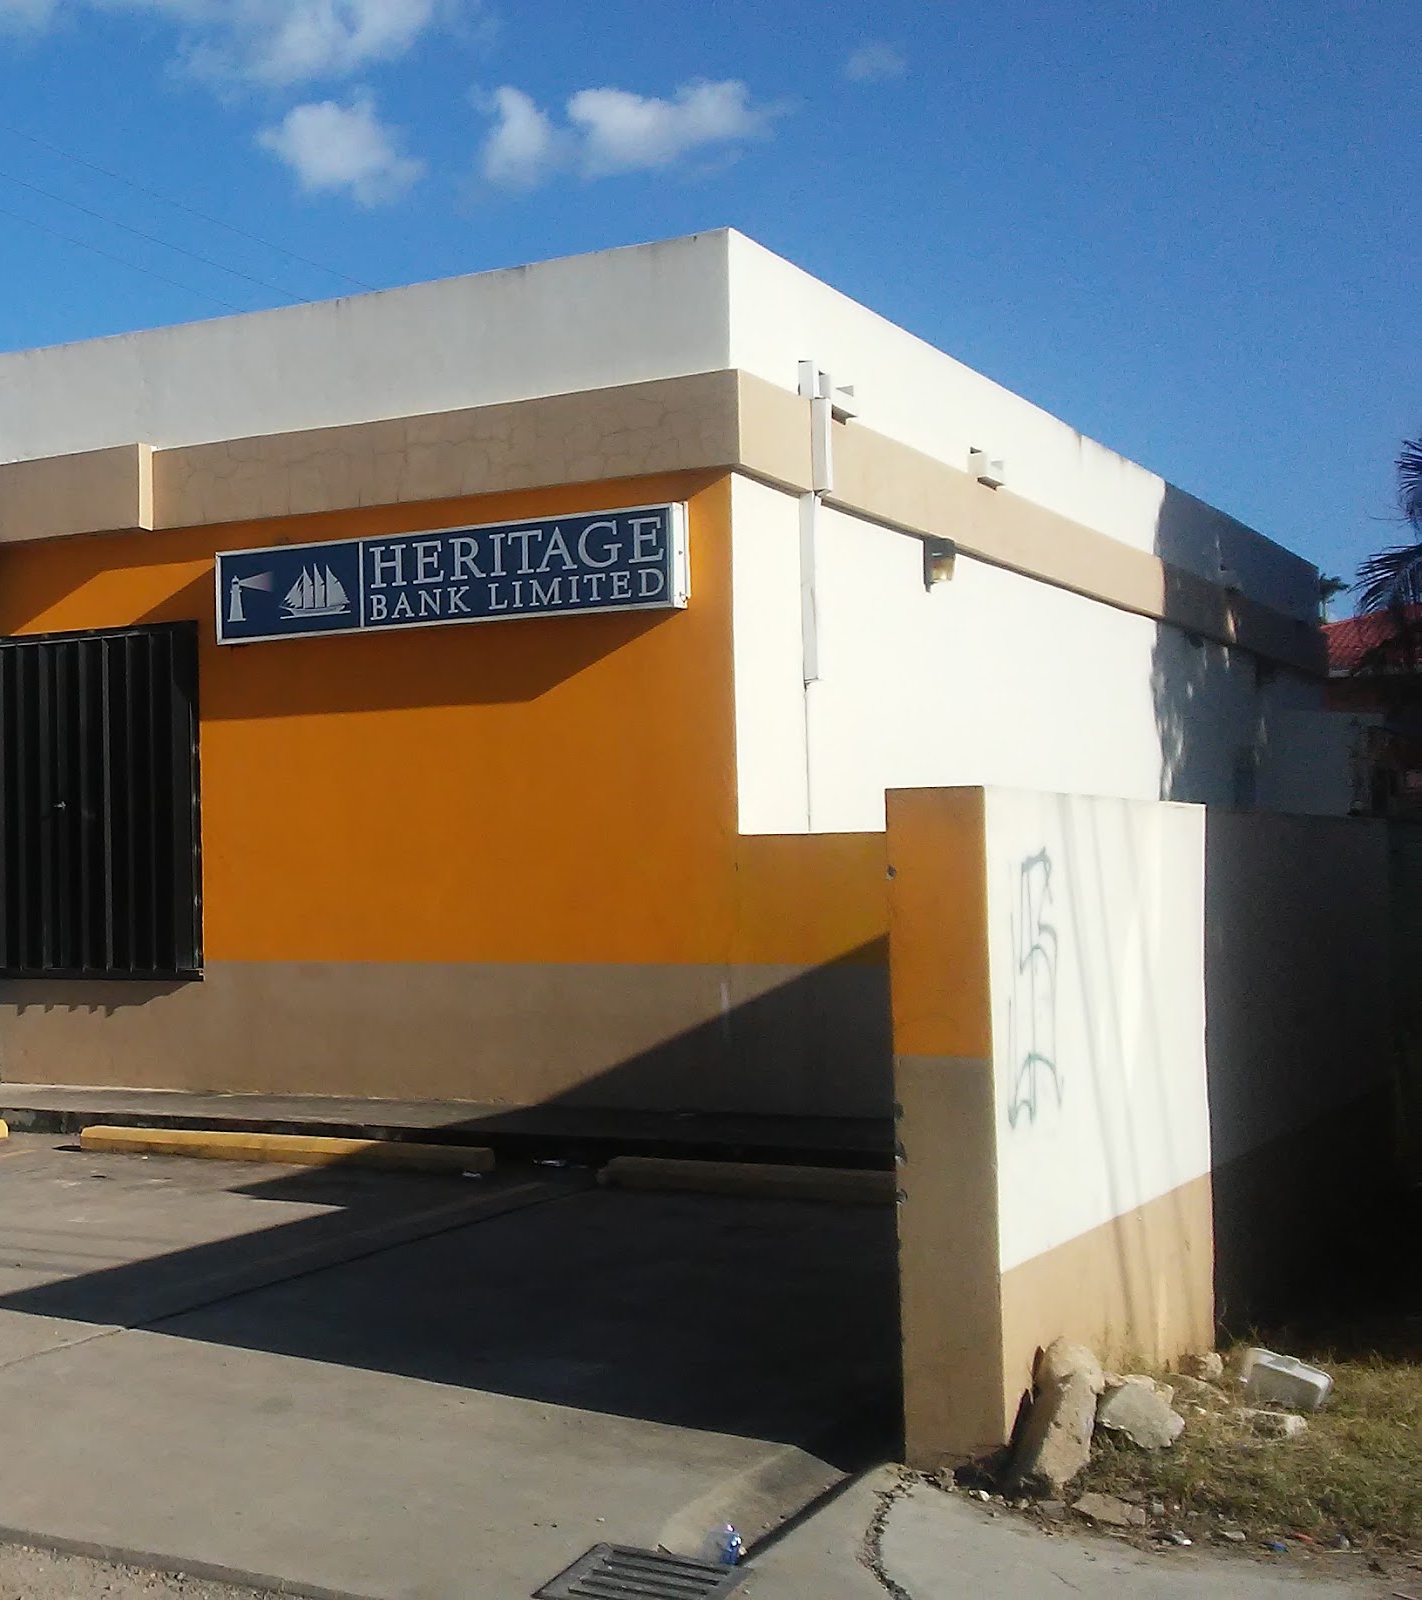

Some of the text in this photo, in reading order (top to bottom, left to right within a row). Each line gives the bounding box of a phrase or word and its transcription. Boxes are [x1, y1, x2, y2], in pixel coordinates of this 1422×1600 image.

[368, 515, 666, 589] HERITAGE
[369, 567, 666, 622] BANK LIMITED
